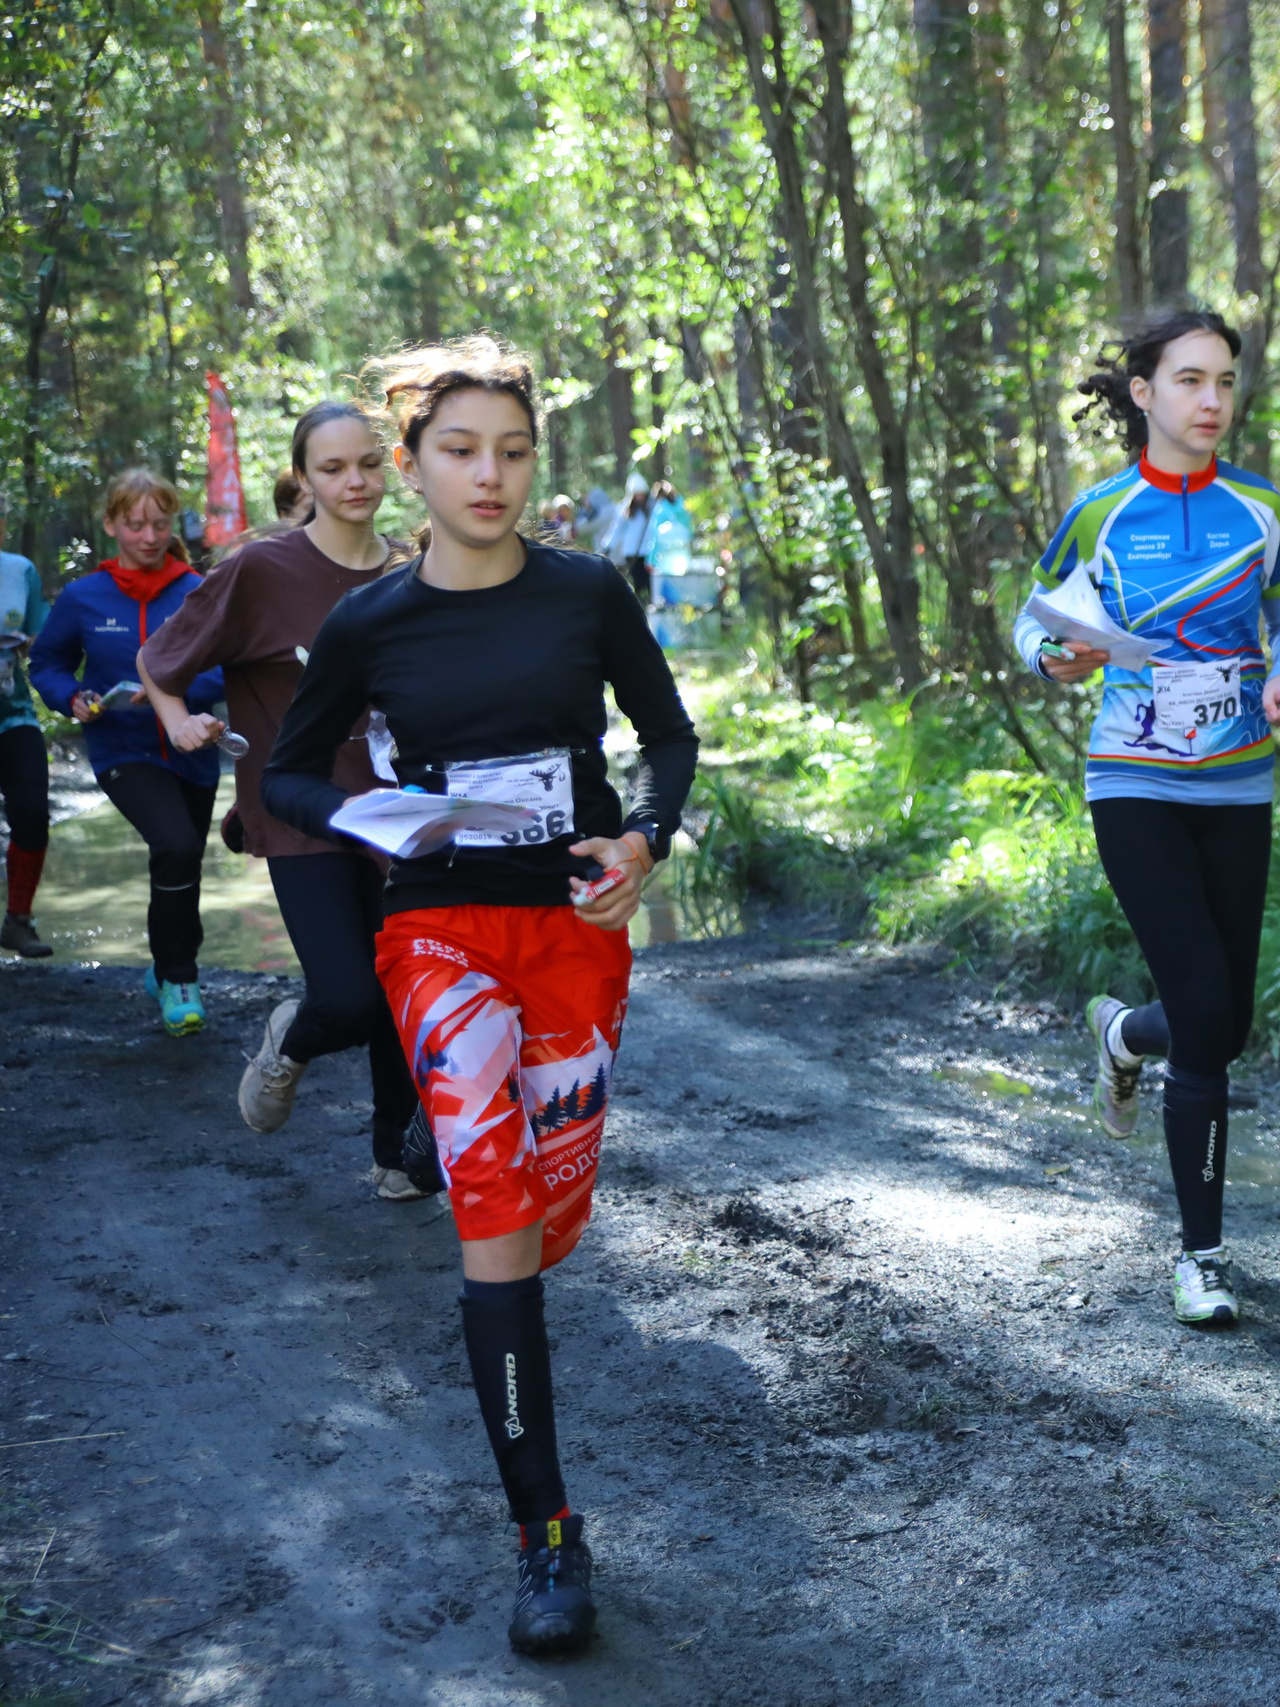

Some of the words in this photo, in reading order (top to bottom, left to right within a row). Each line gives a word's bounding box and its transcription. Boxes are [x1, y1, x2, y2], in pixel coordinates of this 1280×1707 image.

[1130, 534, 1171, 542] Спортивная
[1127, 552, 1172, 561] Екатеринбург
[1193, 696, 1237, 726] 370
[1206, 1120, 1217, 1166] NORD
[505, 1353, 518, 1416] NORD
